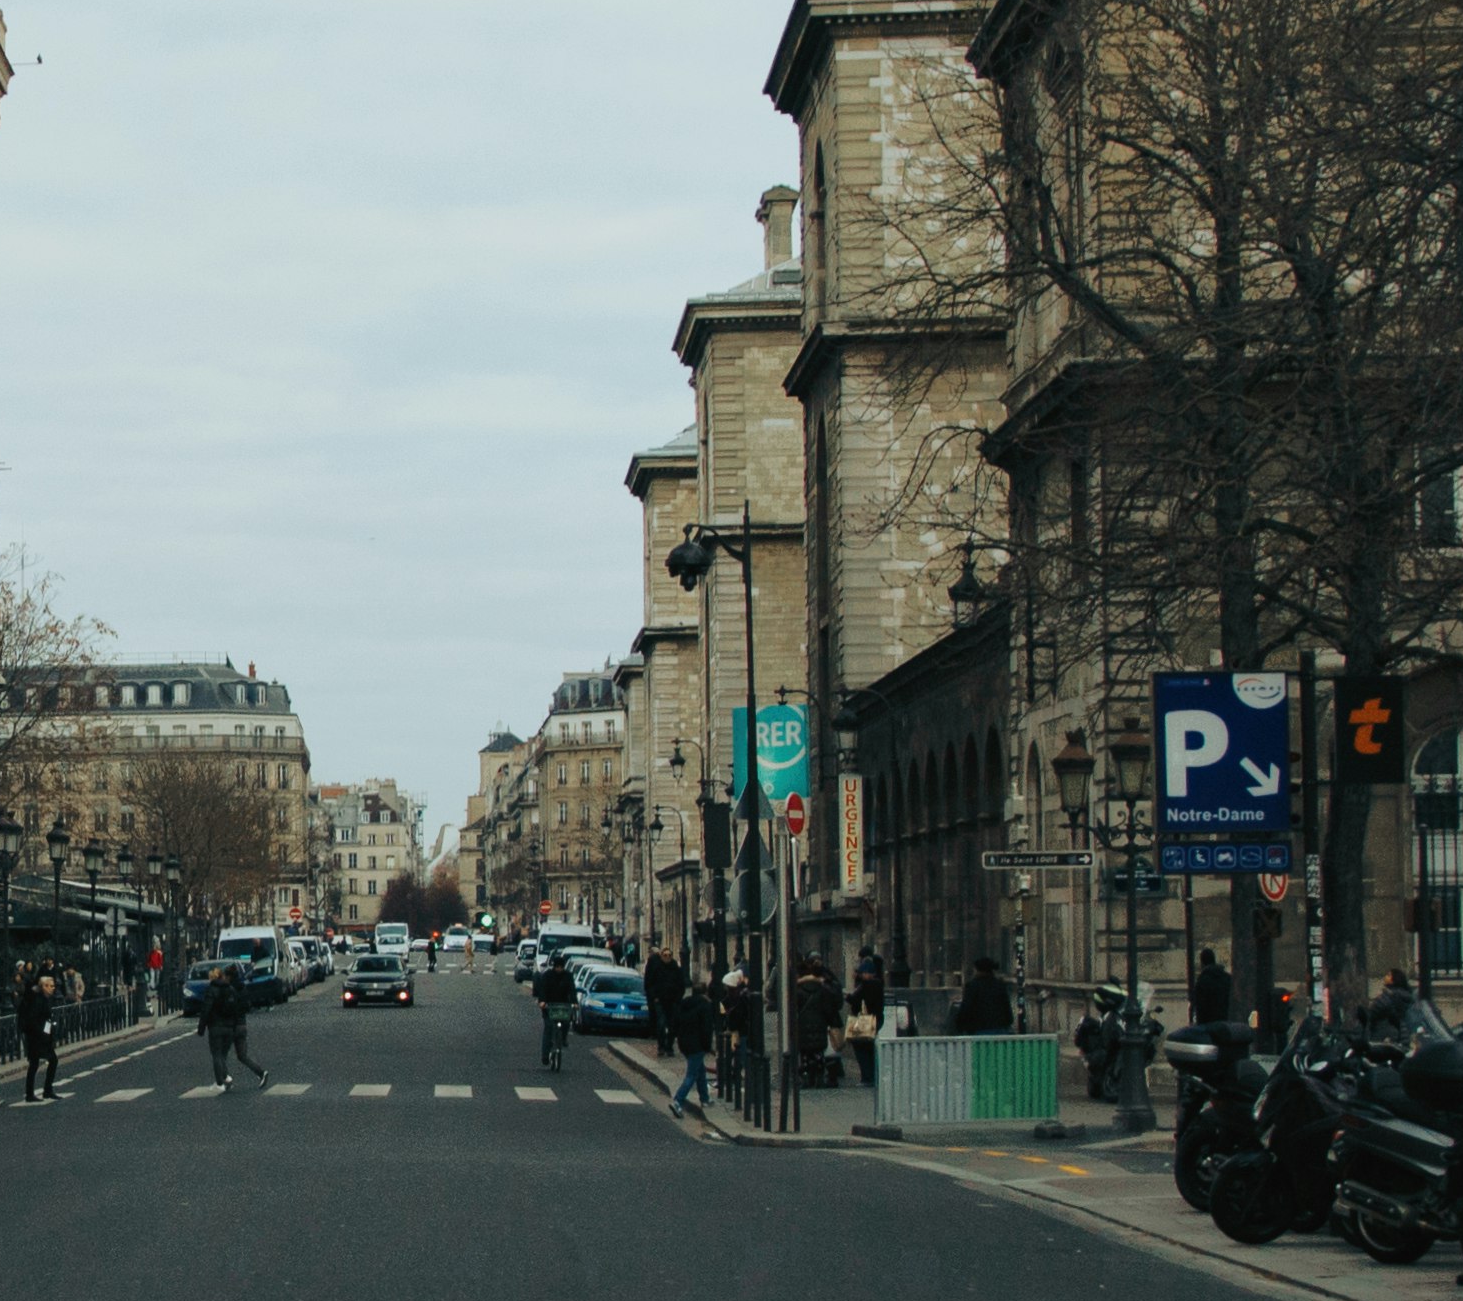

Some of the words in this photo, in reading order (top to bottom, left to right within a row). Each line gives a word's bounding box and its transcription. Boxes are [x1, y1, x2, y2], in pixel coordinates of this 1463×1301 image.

[756, 720, 802, 747] RER
[1164, 709, 1229, 798] P
[1167, 807, 1265, 822] Notre-Dame
